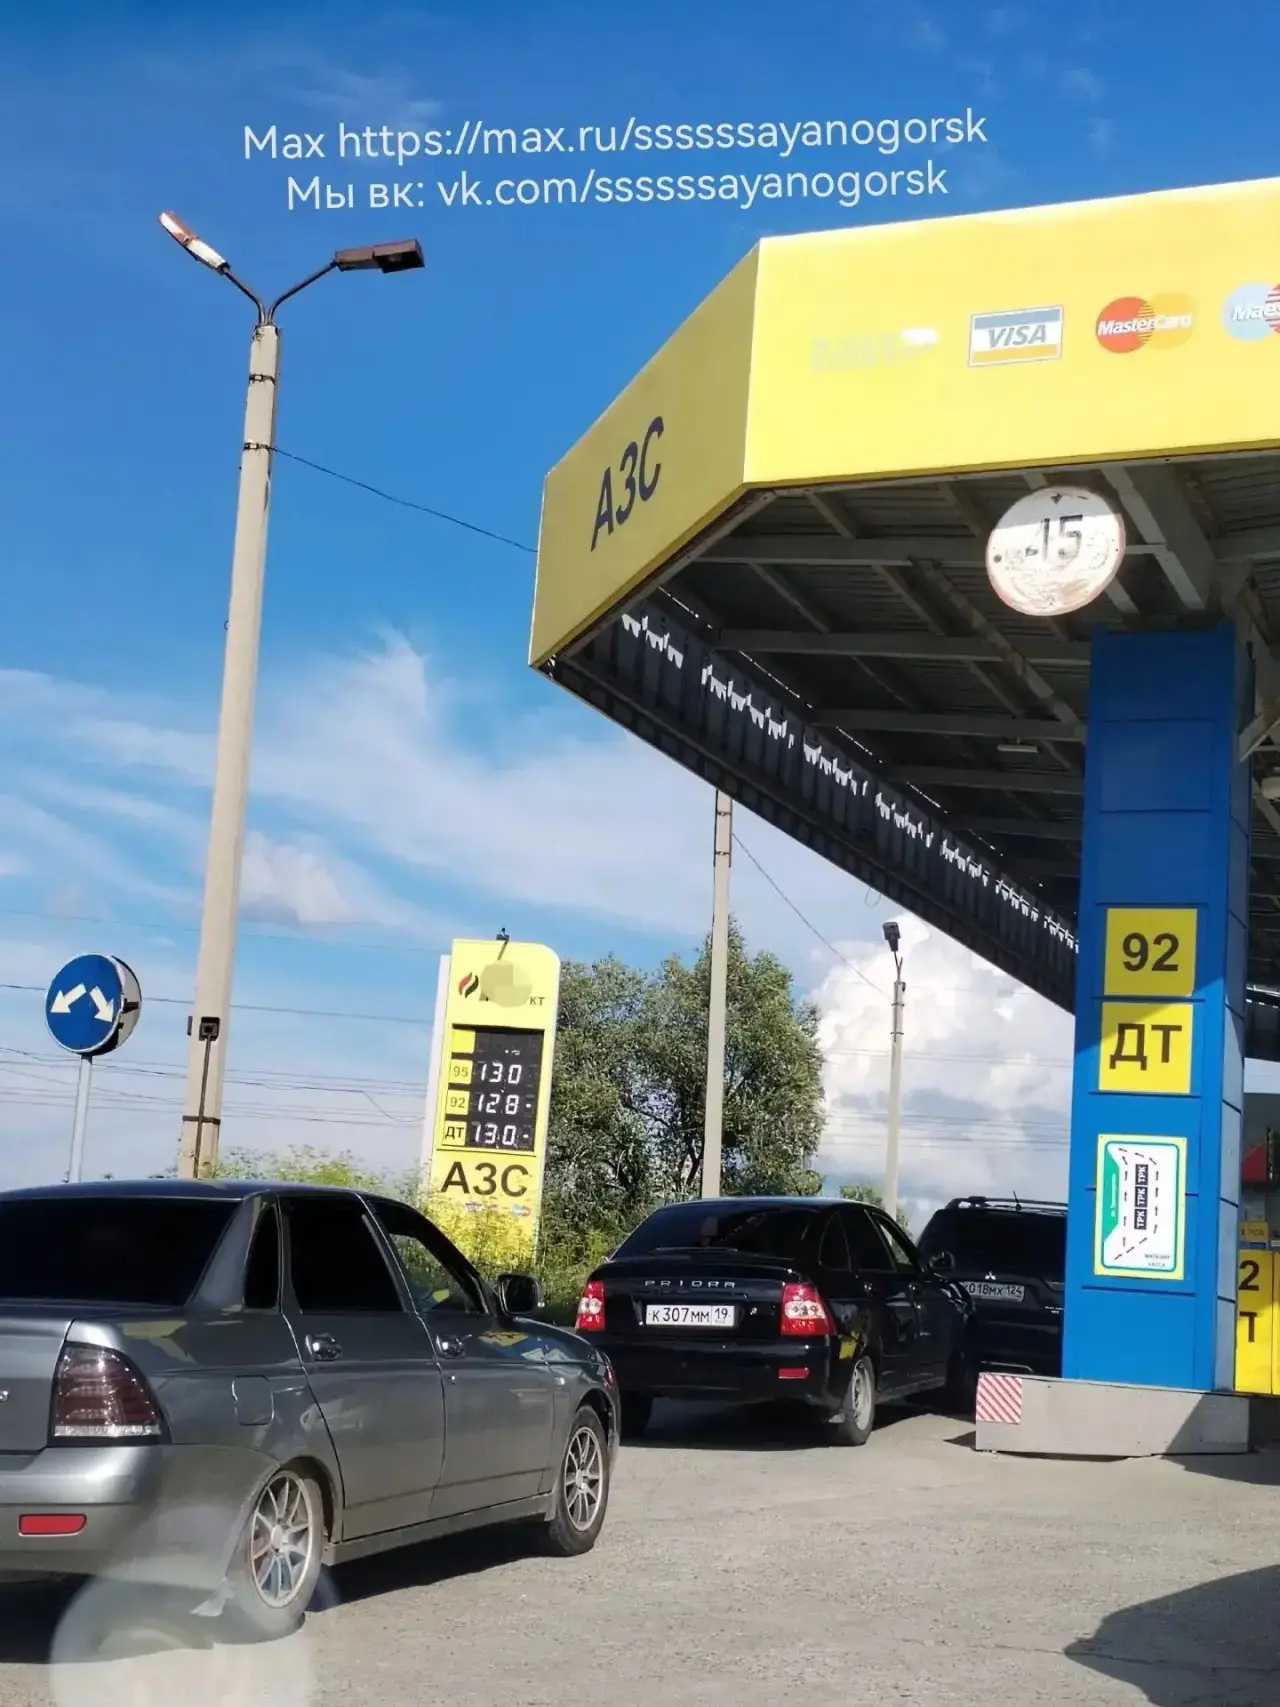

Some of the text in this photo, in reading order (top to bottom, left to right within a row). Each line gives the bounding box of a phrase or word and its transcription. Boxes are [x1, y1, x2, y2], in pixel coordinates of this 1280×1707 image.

[987, 324, 1047, 349] VISA
[1097, 312, 1193, 337] MasterCard
[590, 415, 665, 552] АЗС
[1122, 932, 1180, 972] 92
[1109, 1022, 1183, 1071] ДТ
[453, 1061, 522, 1084] 95 130
[450, 1096, 466, 1109] 92
[445, 1126, 465, 1140] ДТ
[440, 1161, 529, 1198] АЗС
[645, 1279, 736, 1288] PRIORA
[1238, 1259, 1260, 1291] 2
[1239, 1310, 1258, 1343] Т
